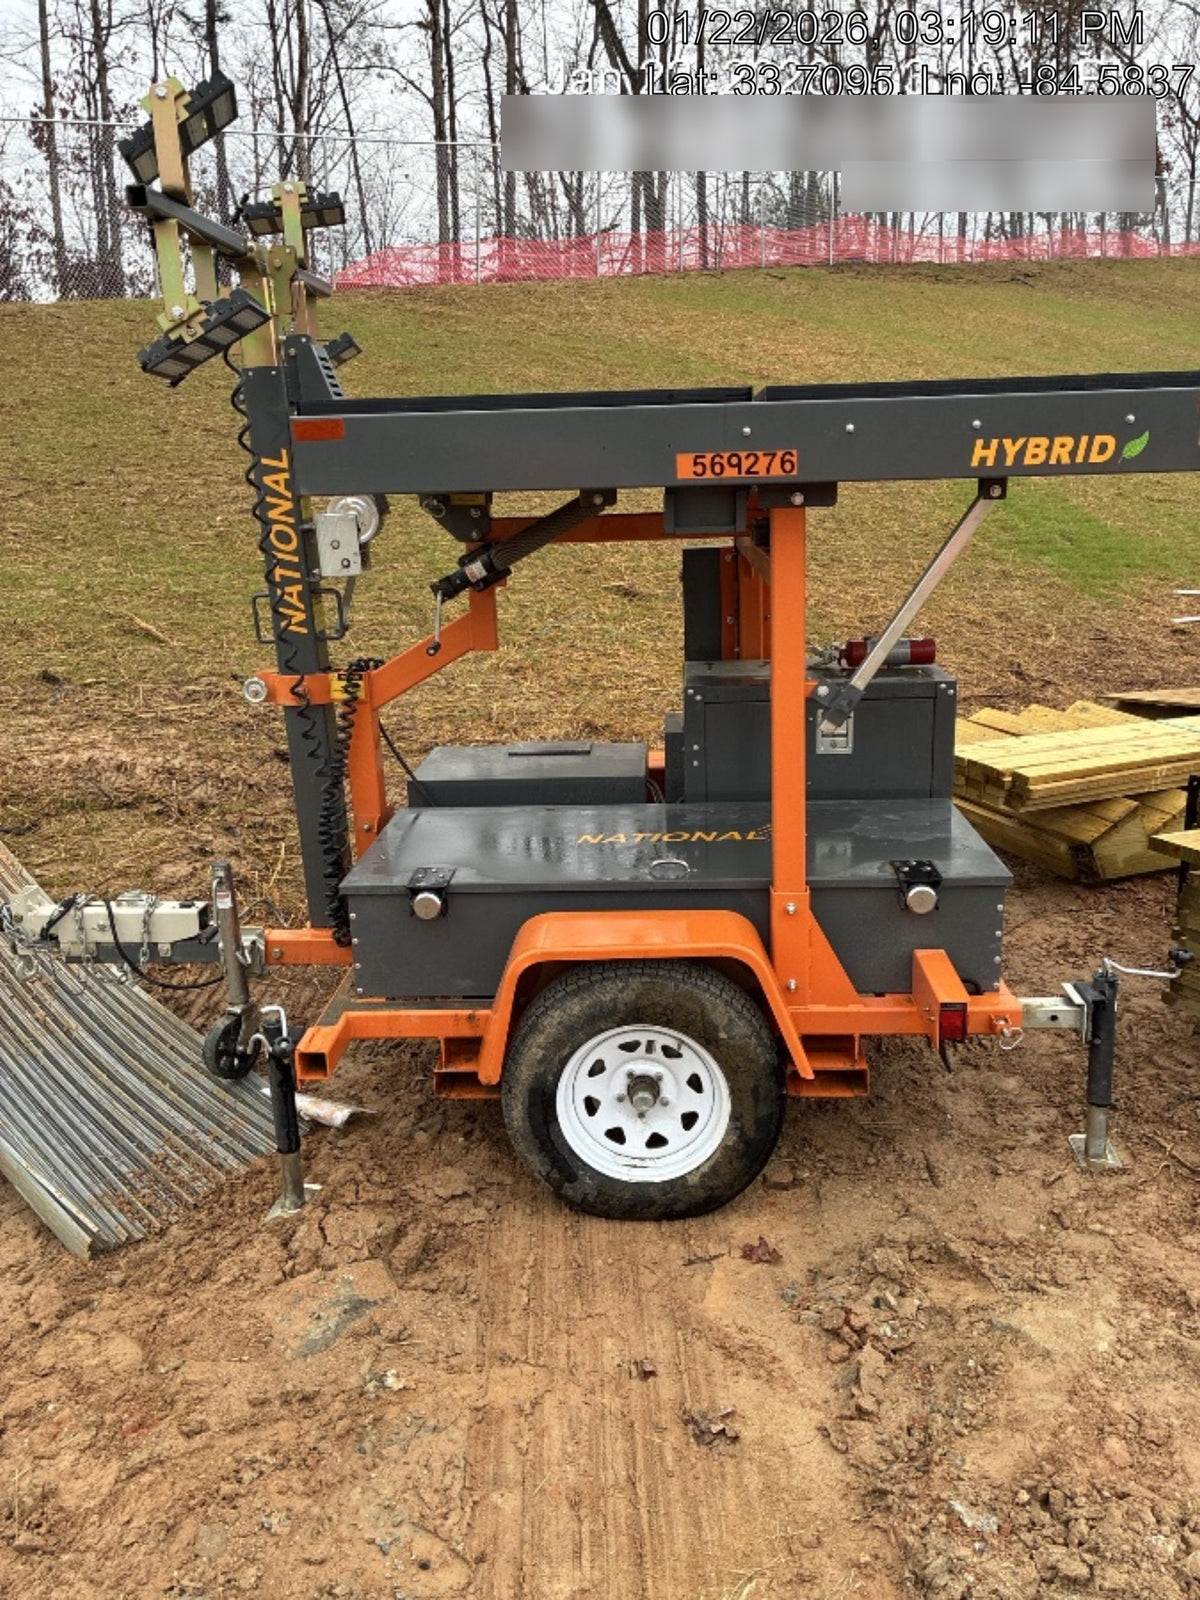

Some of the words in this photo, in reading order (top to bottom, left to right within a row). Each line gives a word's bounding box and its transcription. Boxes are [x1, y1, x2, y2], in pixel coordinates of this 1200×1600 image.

[692, 451, 796, 477] 569276
[970, 434, 1117, 467] HYBRID
[260, 448, 308, 634] NATIONAL
[576, 831, 768, 844] NATIONAL
